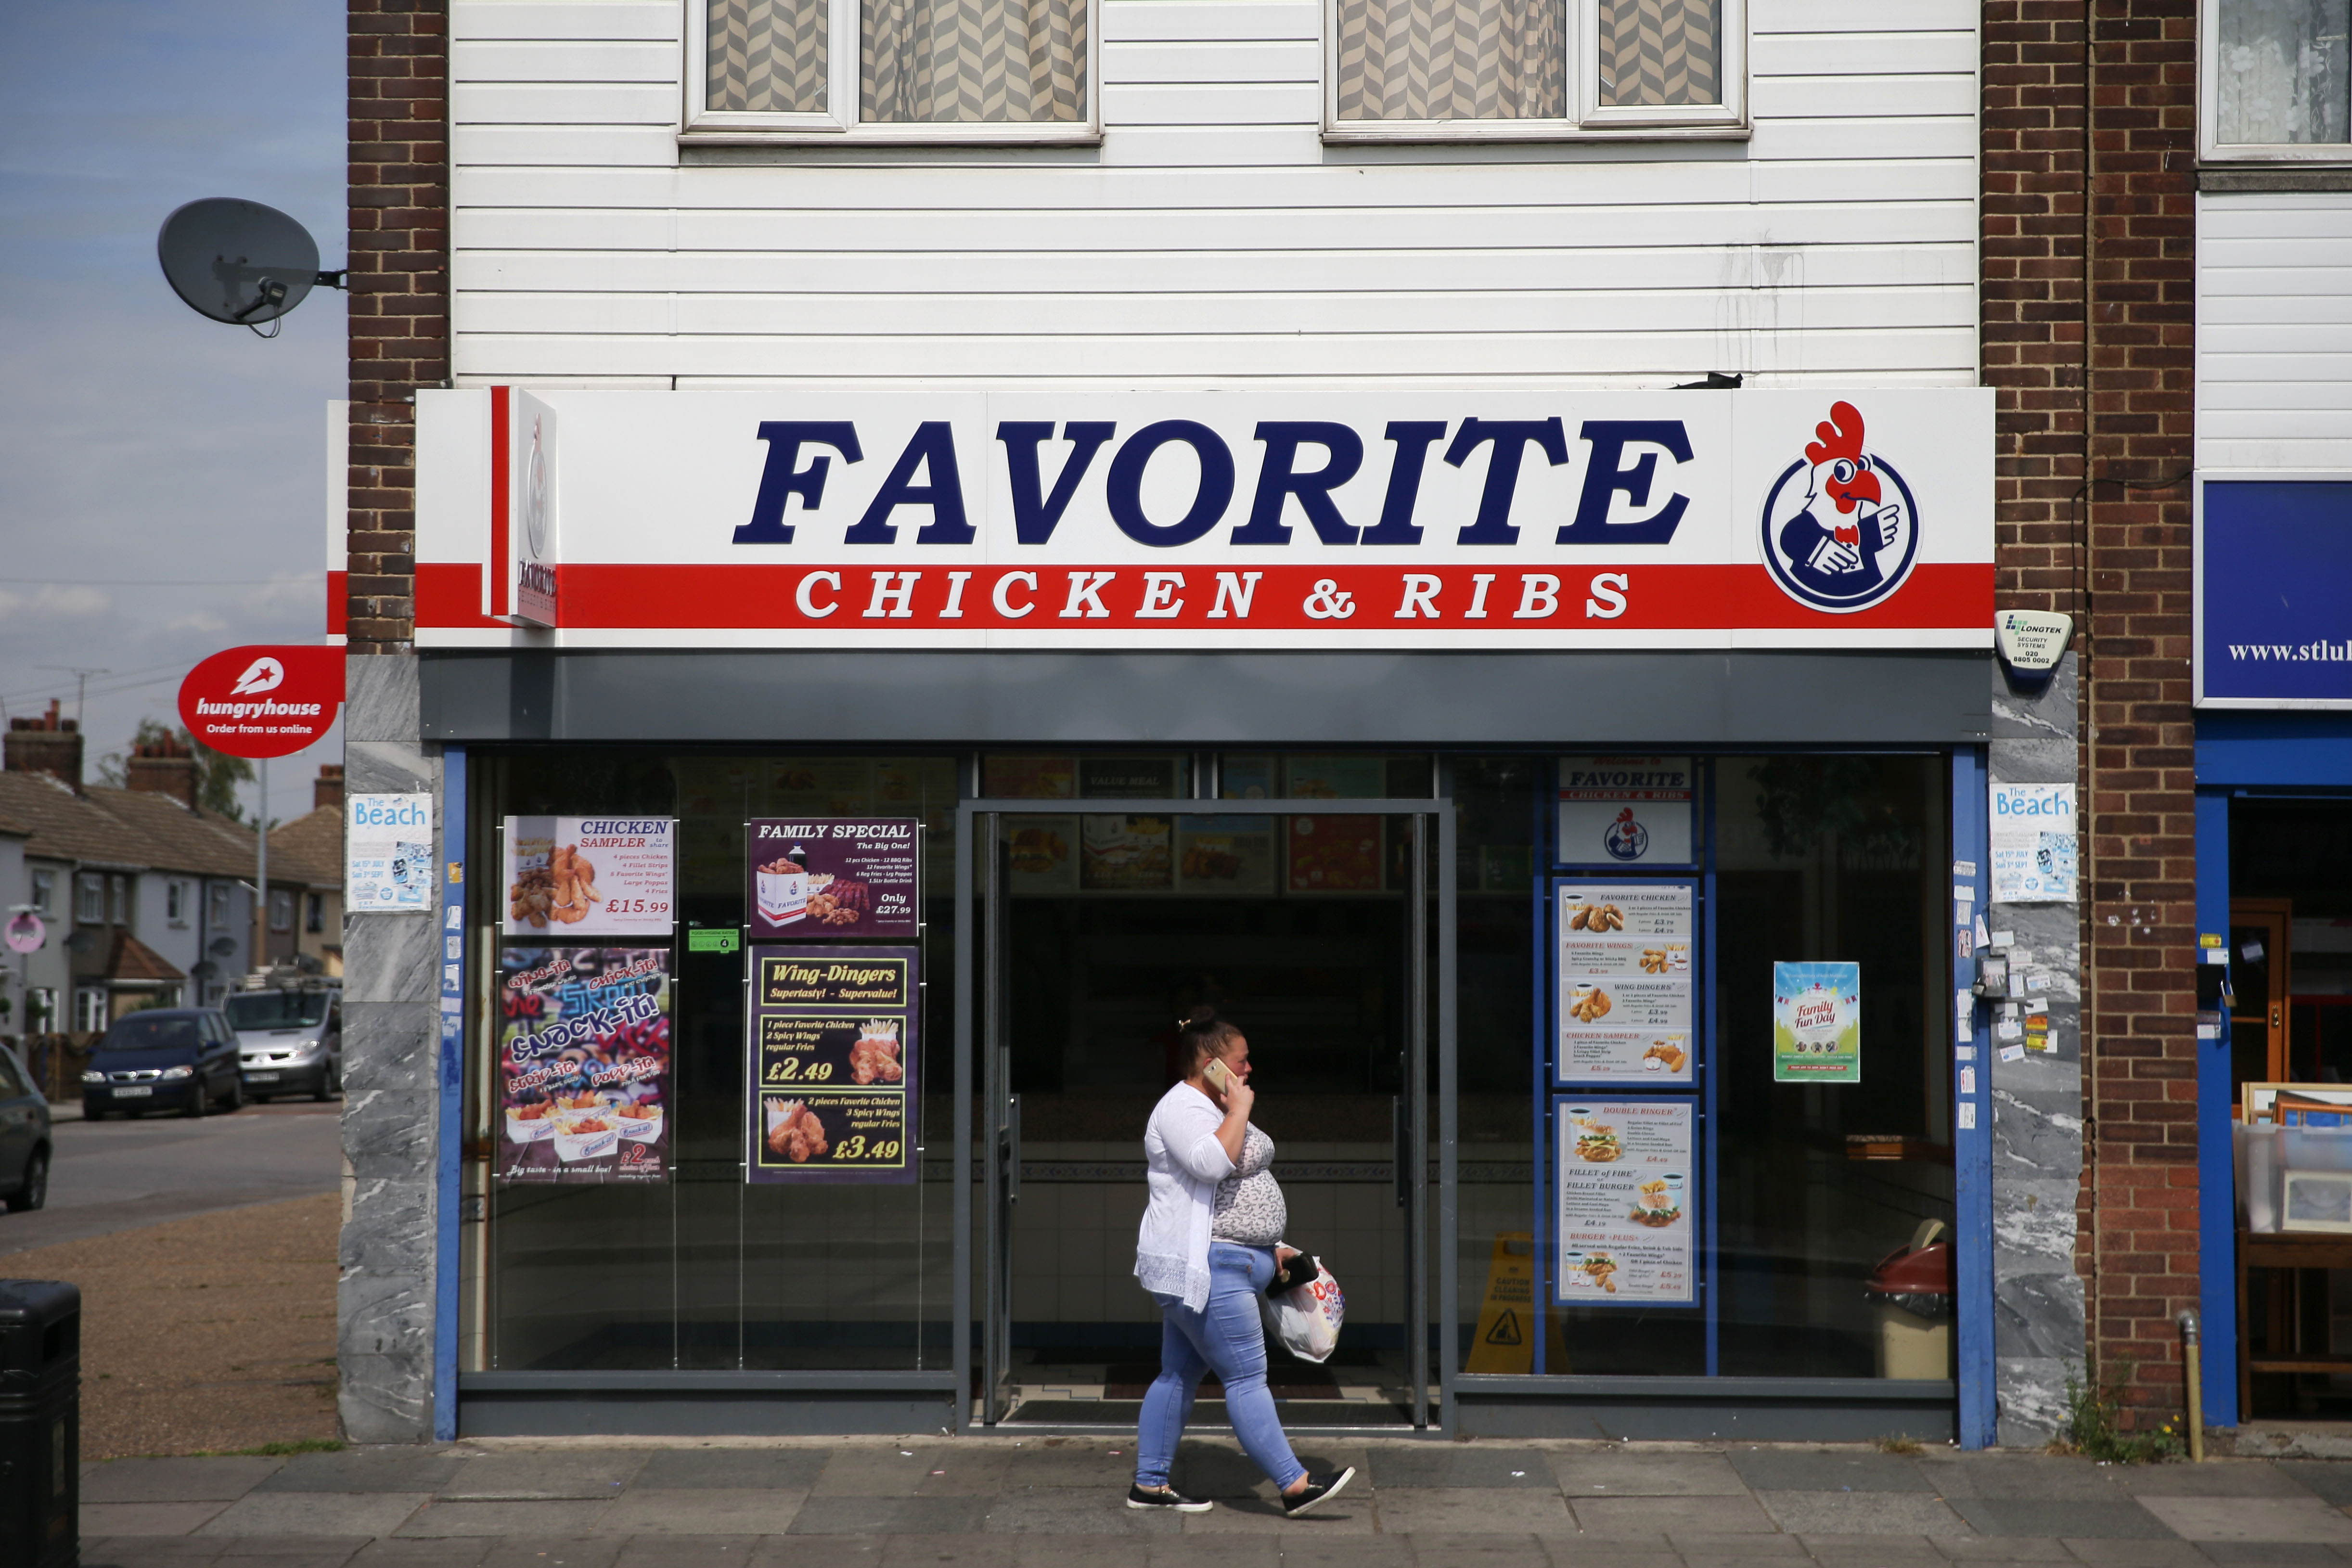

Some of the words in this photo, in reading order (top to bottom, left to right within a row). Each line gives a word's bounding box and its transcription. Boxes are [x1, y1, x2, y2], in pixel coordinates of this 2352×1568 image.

[732, 417, 1694, 547] FAVORITE
[796, 571, 1262, 618] CHICKEN
[1302, 578, 1356, 619] &
[1394, 573, 1629, 618] RIBS
[196, 697, 321, 719] hungryhouse
[206, 724, 237, 733] Order
[239, 724, 264, 733] from
[280, 724, 312, 734] online
[1090, 776, 1126, 785] VALUE
[1129, 776, 1159, 785] MEAL
[1569, 771, 1684, 786] FAVORITE
[1569, 790, 1631, 798] CHICKEN
[2009, 788, 2026, 796] The
[368, 798, 384, 806] The
[1997, 793, 2069, 815] Beach
[356, 802, 425, 825] Beach
[581, 821, 668, 834] CHICKEN
[758, 825, 828, 838] FAMILY
[833, 825, 911, 838] SPECIAL
[580, 838, 645, 848] SAMPLER
[778, 897, 806, 909] FAVORITE
[881, 893, 906, 903] Only
[606, 899, 668, 913] £15.99
[876, 905, 911, 914] £27.99
[773, 964, 896, 985] Wing-Dingers
[770, 988, 826, 999] Supertasty!
[838, 988, 897, 1000] Supervalue!
[1797, 1001, 1833, 1017] Family
[773, 1021, 793, 1029] piece
[1795, 1017, 1812, 1029] Fun
[1815, 1012, 1836, 1024] Day
[773, 1032, 795, 1041] Spicy
[766, 1043, 795, 1052] regular
[766, 1057, 833, 1080] £2.49
[815, 1097, 838, 1106] pieces
[853, 1108, 874, 1118] Spicy
[851, 1120, 880, 1129] regular
[833, 1135, 899, 1158] £3.49
[507, 1165, 525, 1176] Big
[571, 1165, 593, 1173] small
[1496, 1277, 1530, 1285] CAUTION
[1494, 1286, 1530, 1294] CLEANING
[1498, 1294, 1531, 1303] PROGRESS
